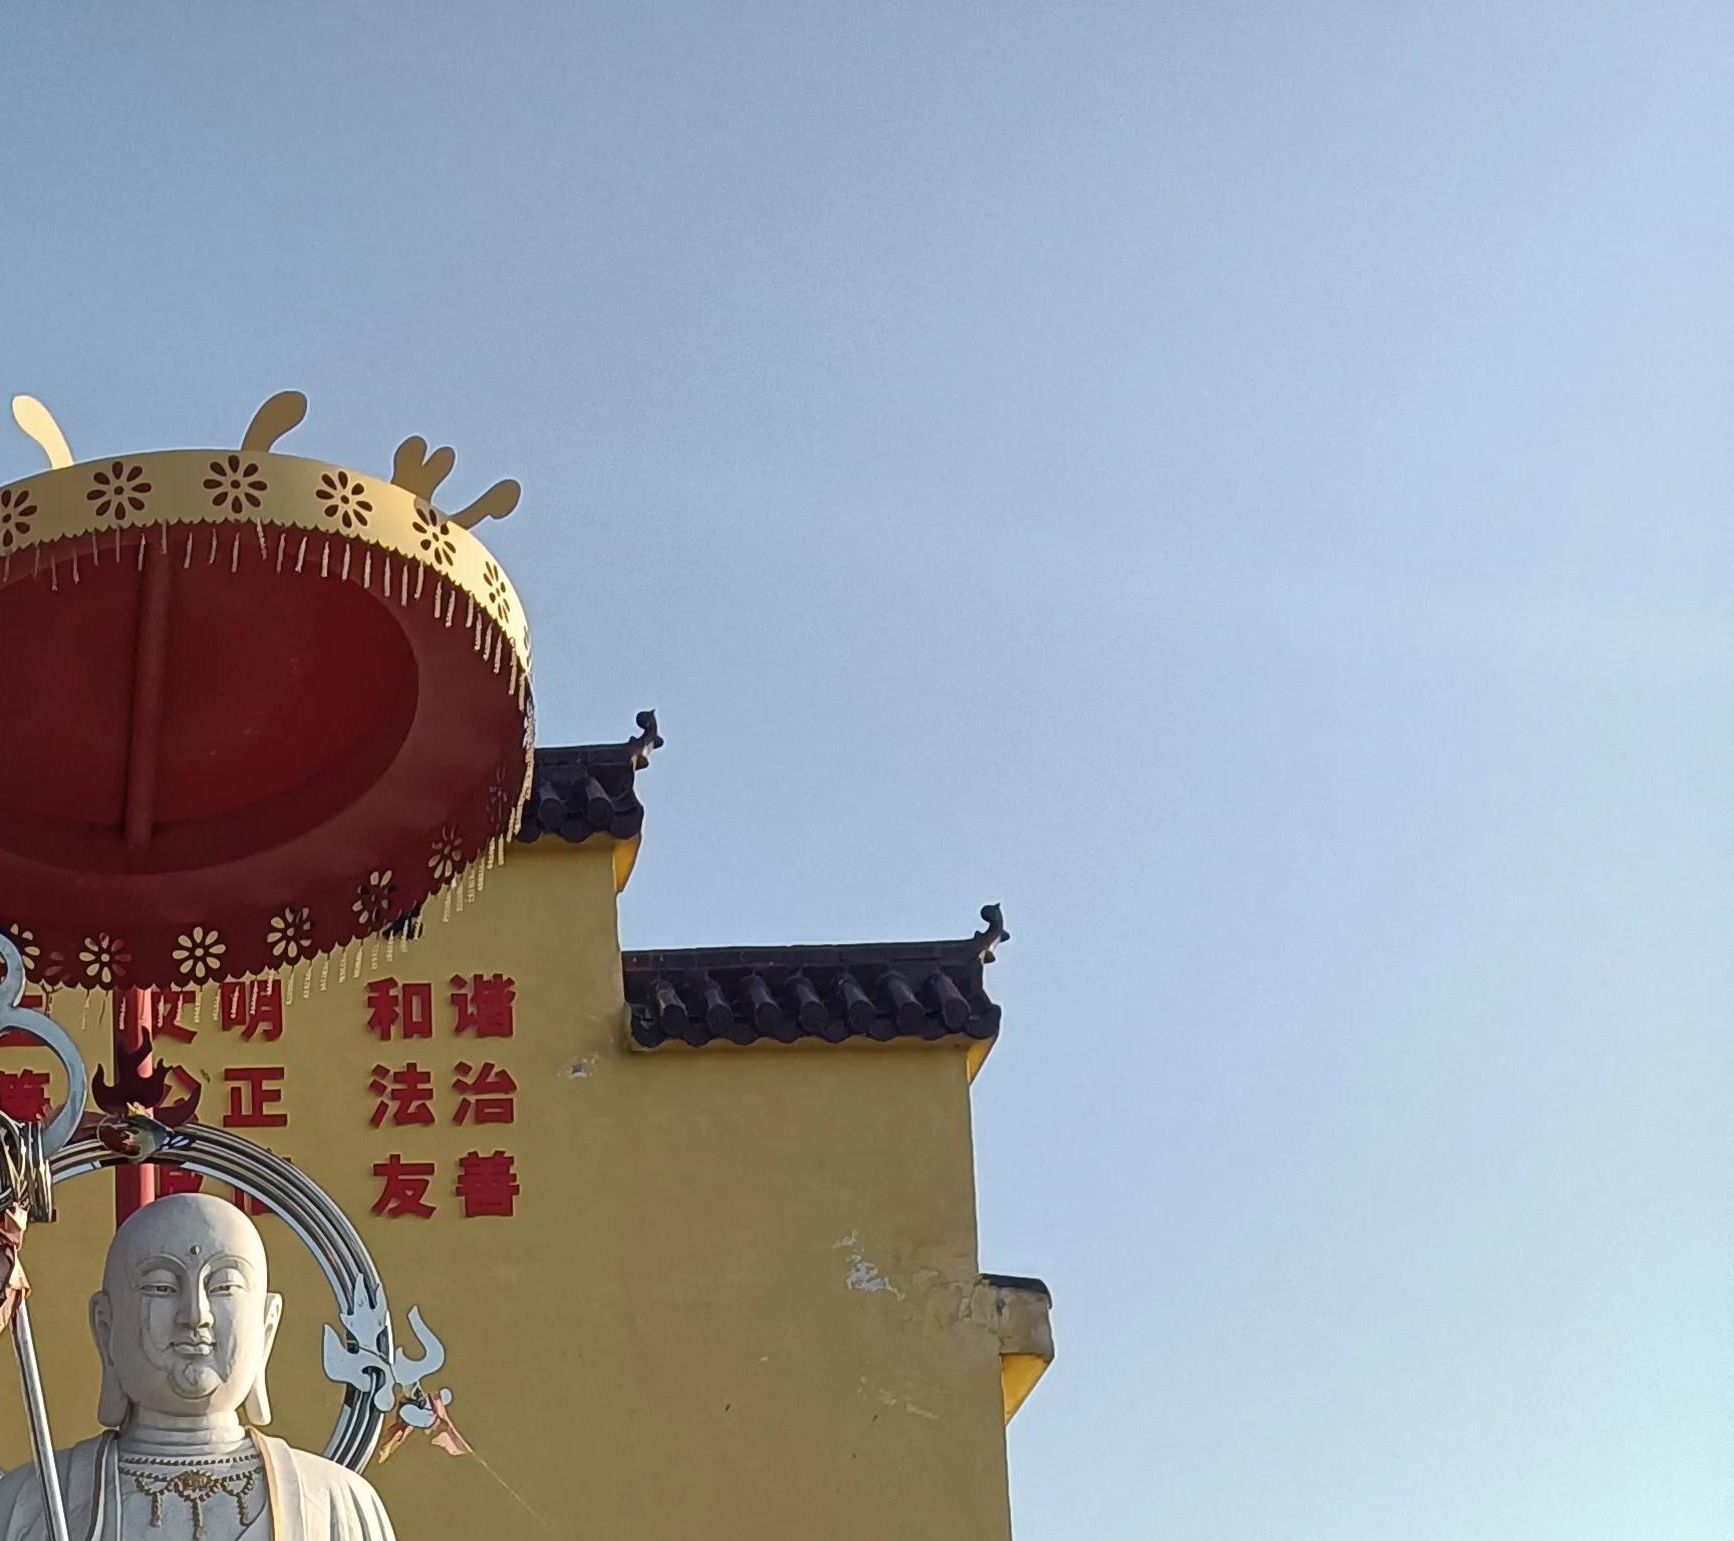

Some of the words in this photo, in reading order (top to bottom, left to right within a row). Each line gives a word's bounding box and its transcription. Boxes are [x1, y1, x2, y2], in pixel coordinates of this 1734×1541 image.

[366, 973, 516, 1041] 和谐
[369, 1060, 517, 1129] 法治
[371, 1150, 520, 1219] 友善
